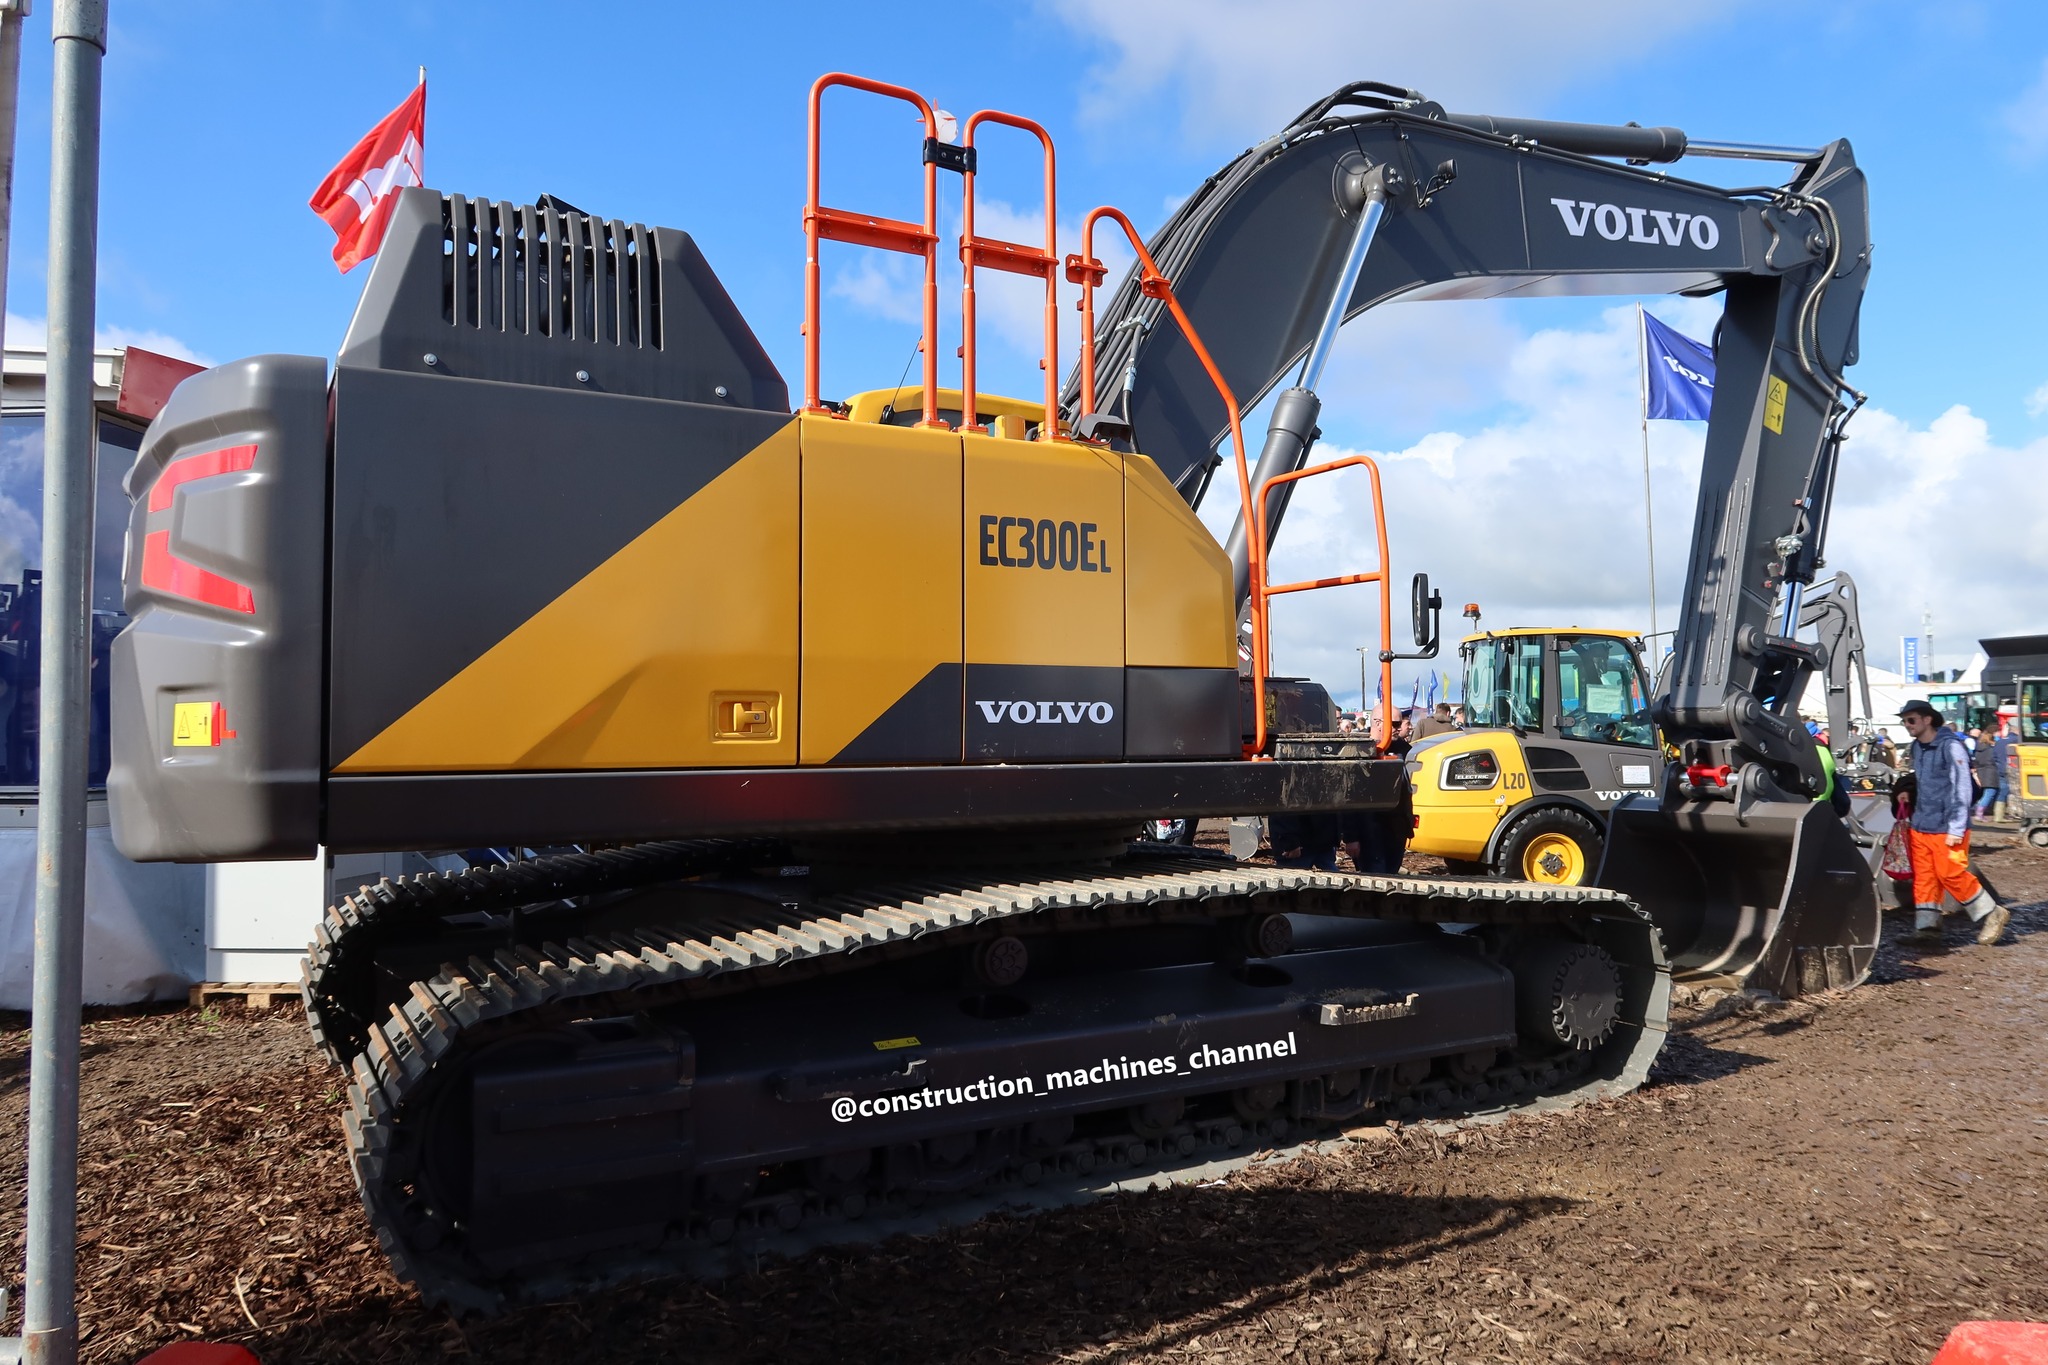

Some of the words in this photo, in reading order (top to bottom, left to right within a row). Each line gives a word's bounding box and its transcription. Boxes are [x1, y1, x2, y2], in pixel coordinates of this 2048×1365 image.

[1550, 198, 1720, 251] VOLVO
[1907, 642, 1916, 683] ZURICH
[975, 700, 1114, 725] VOLVO
[1503, 772, 1526, 790] L20
